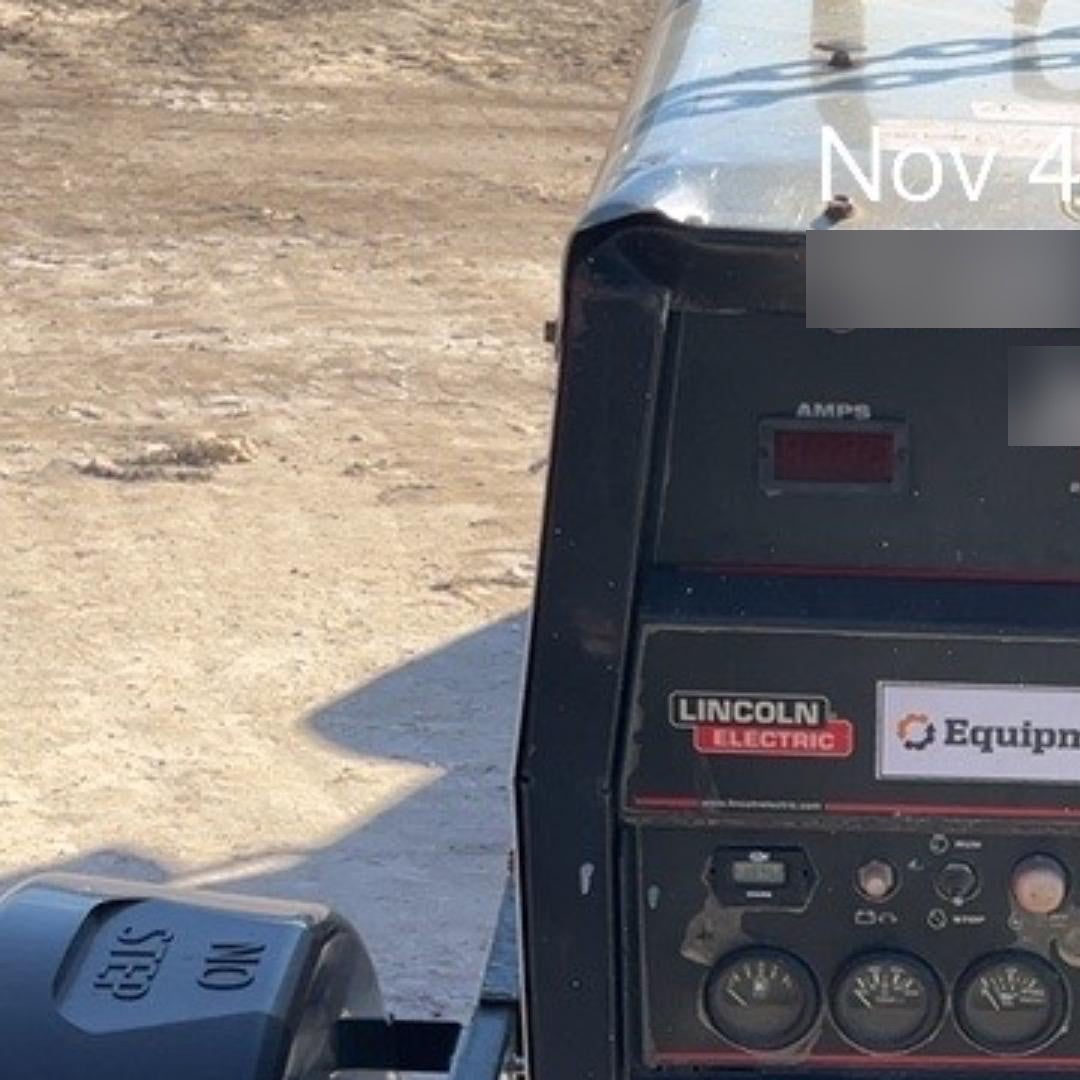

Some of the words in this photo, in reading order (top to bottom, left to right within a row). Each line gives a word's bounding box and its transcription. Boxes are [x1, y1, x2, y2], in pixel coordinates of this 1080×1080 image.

[796, 402, 871, 420] AMPS
[679, 698, 819, 725] LINCOLN
[711, 729, 835, 750] ELECTRIC
[92, 926, 175, 1001] STEP
[196, 940, 267, 990] NO
